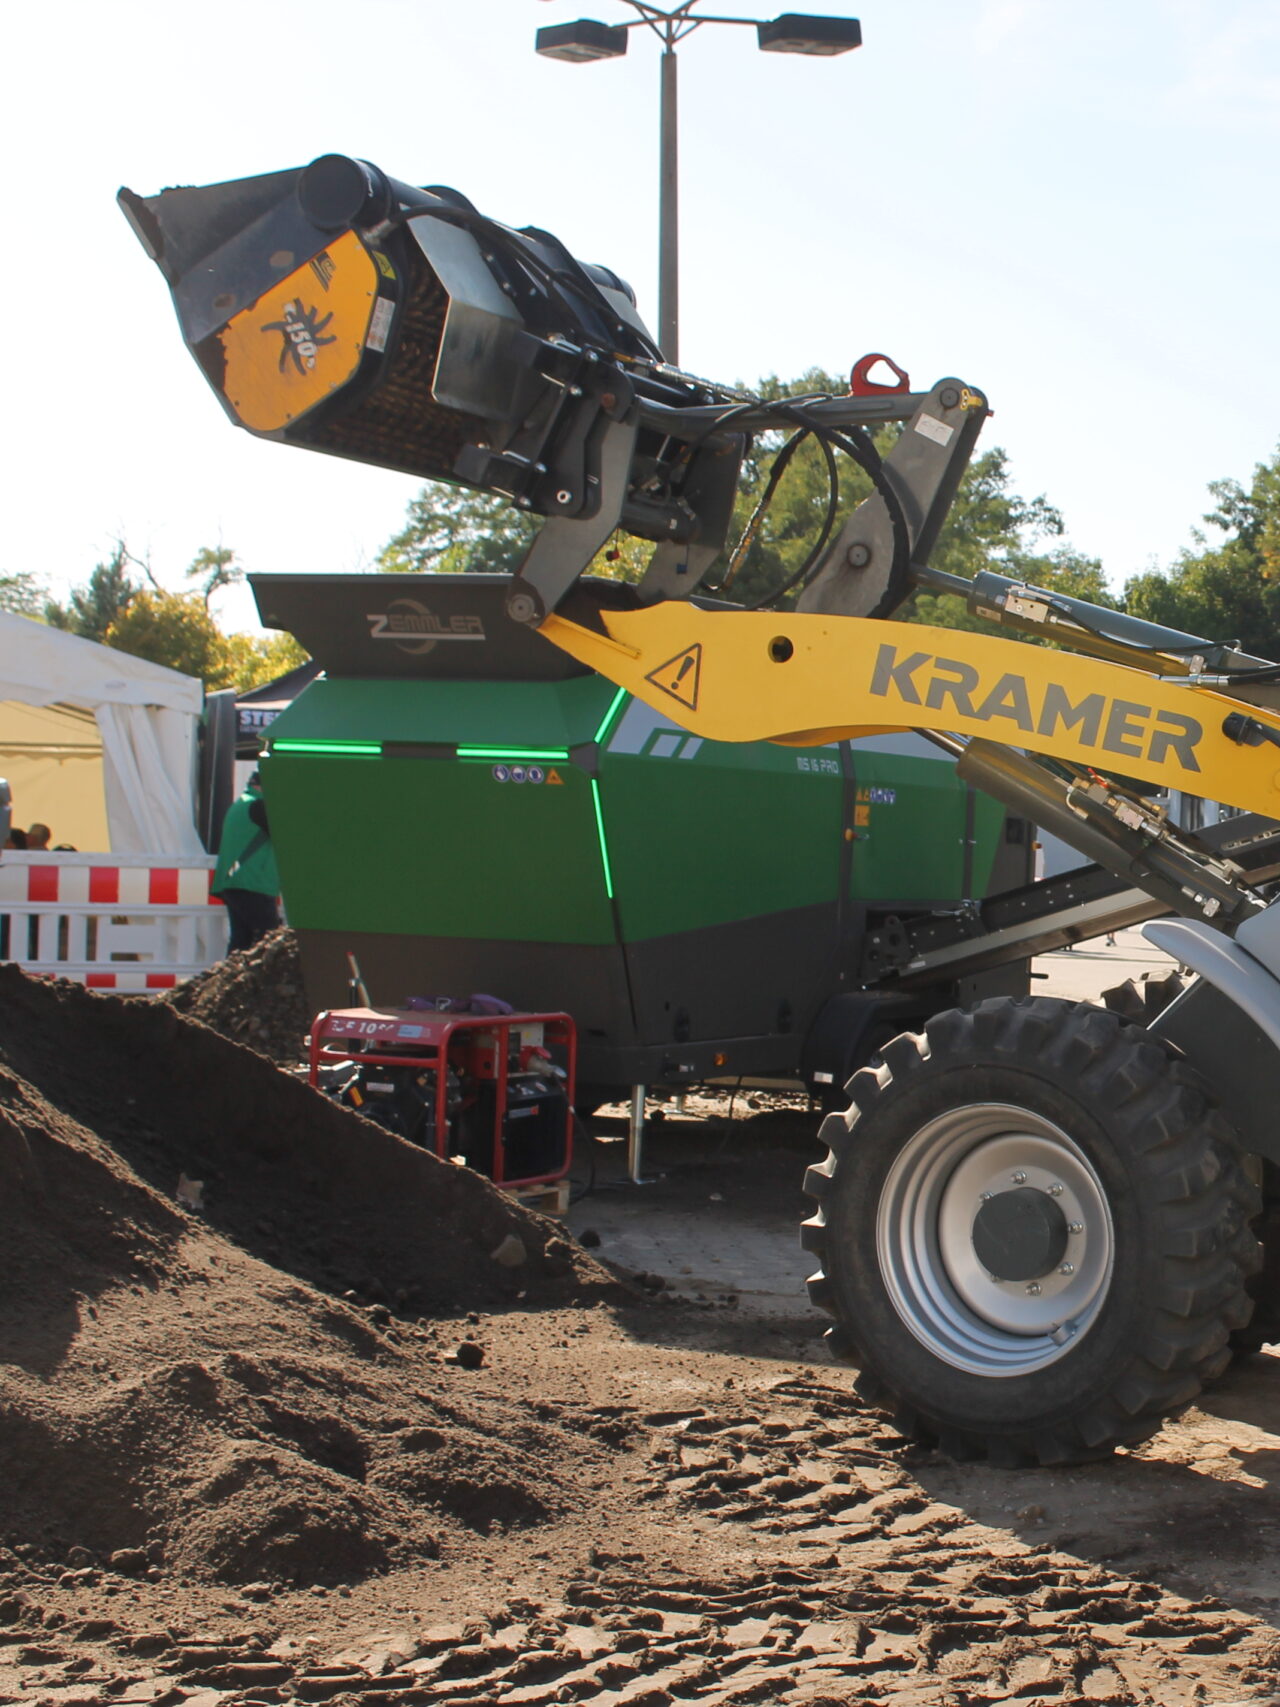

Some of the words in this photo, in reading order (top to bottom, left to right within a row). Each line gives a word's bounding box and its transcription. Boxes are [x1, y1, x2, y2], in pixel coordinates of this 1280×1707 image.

[366, 613, 486, 640] ZEMMLER
[869, 643, 1204, 773] KRAMER
[820, 759, 839, 774] PRO
